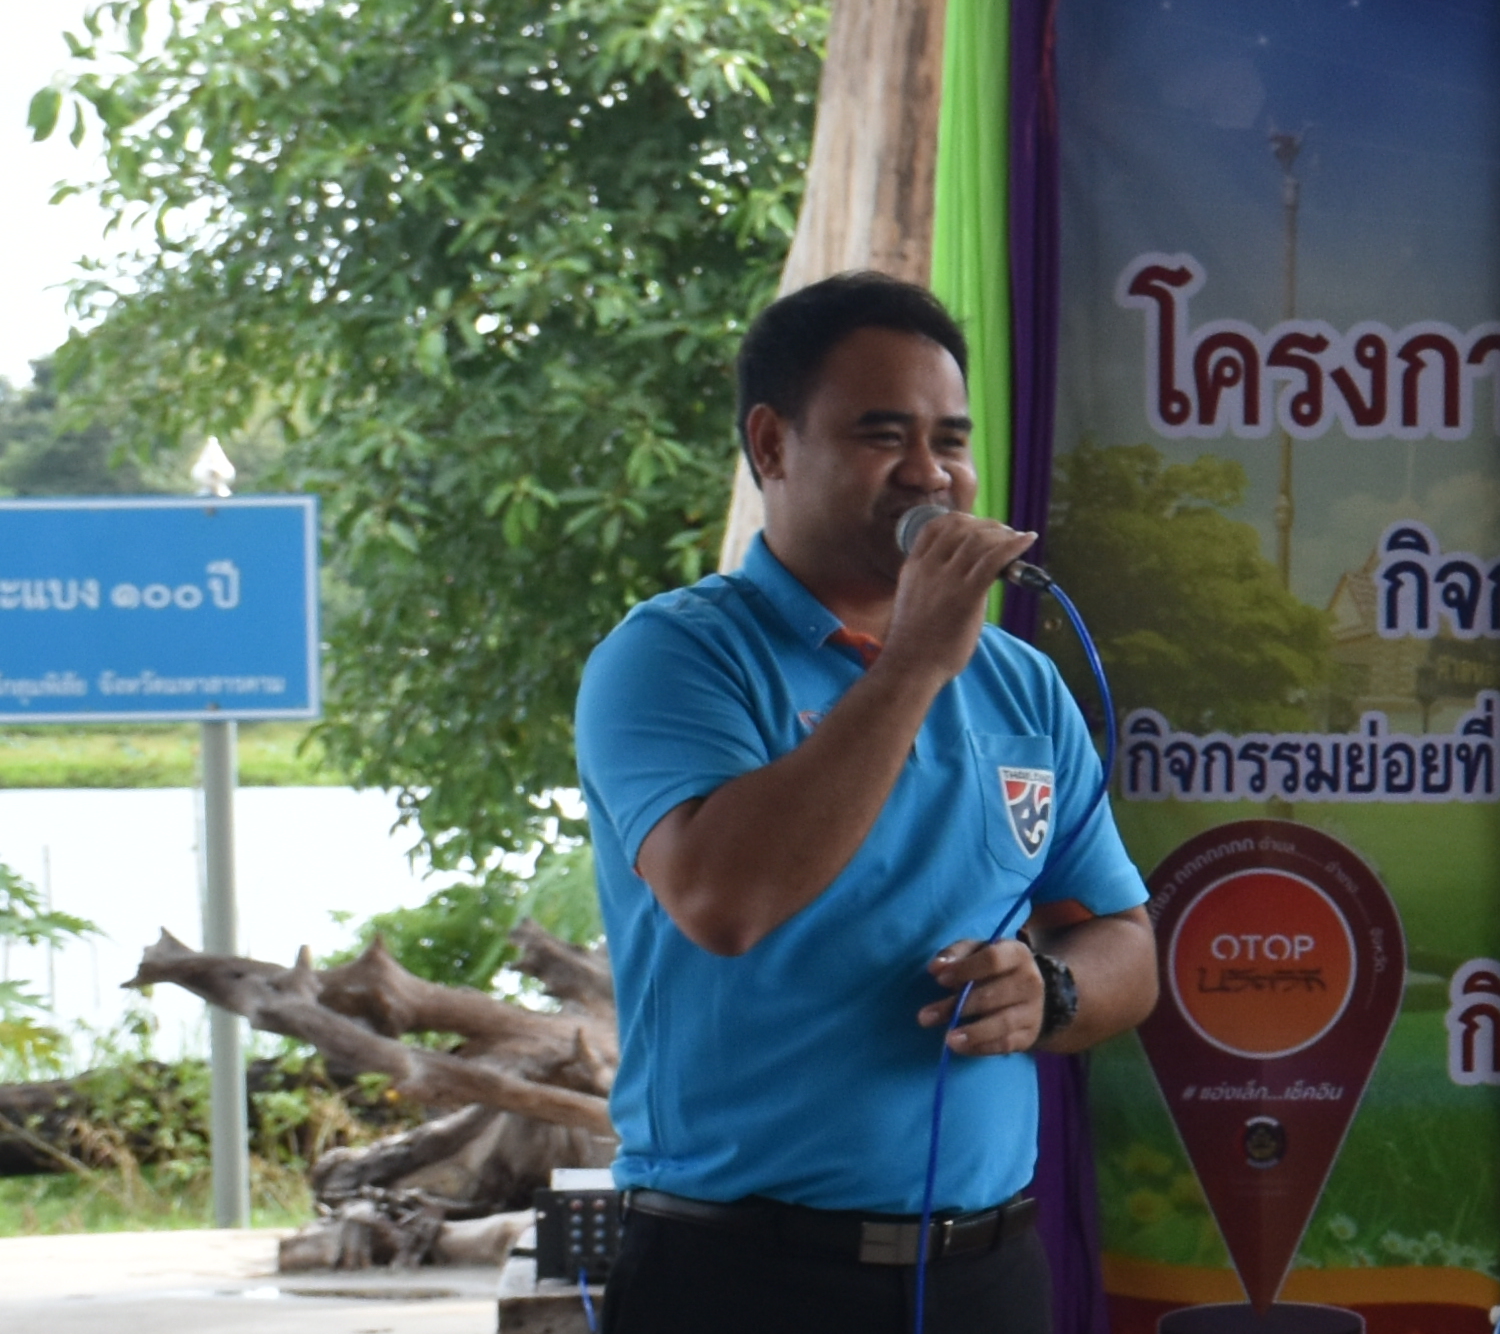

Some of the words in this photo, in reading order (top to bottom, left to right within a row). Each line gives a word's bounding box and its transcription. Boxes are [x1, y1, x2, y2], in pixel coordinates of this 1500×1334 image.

[110, 582, 204, 610] ๑๐๐
[205, 559, 242, 610] ปี
[1127, 698, 1496, 795] กิจกรรมย่อยที่
[1210, 933, 1316, 962] OTOP
